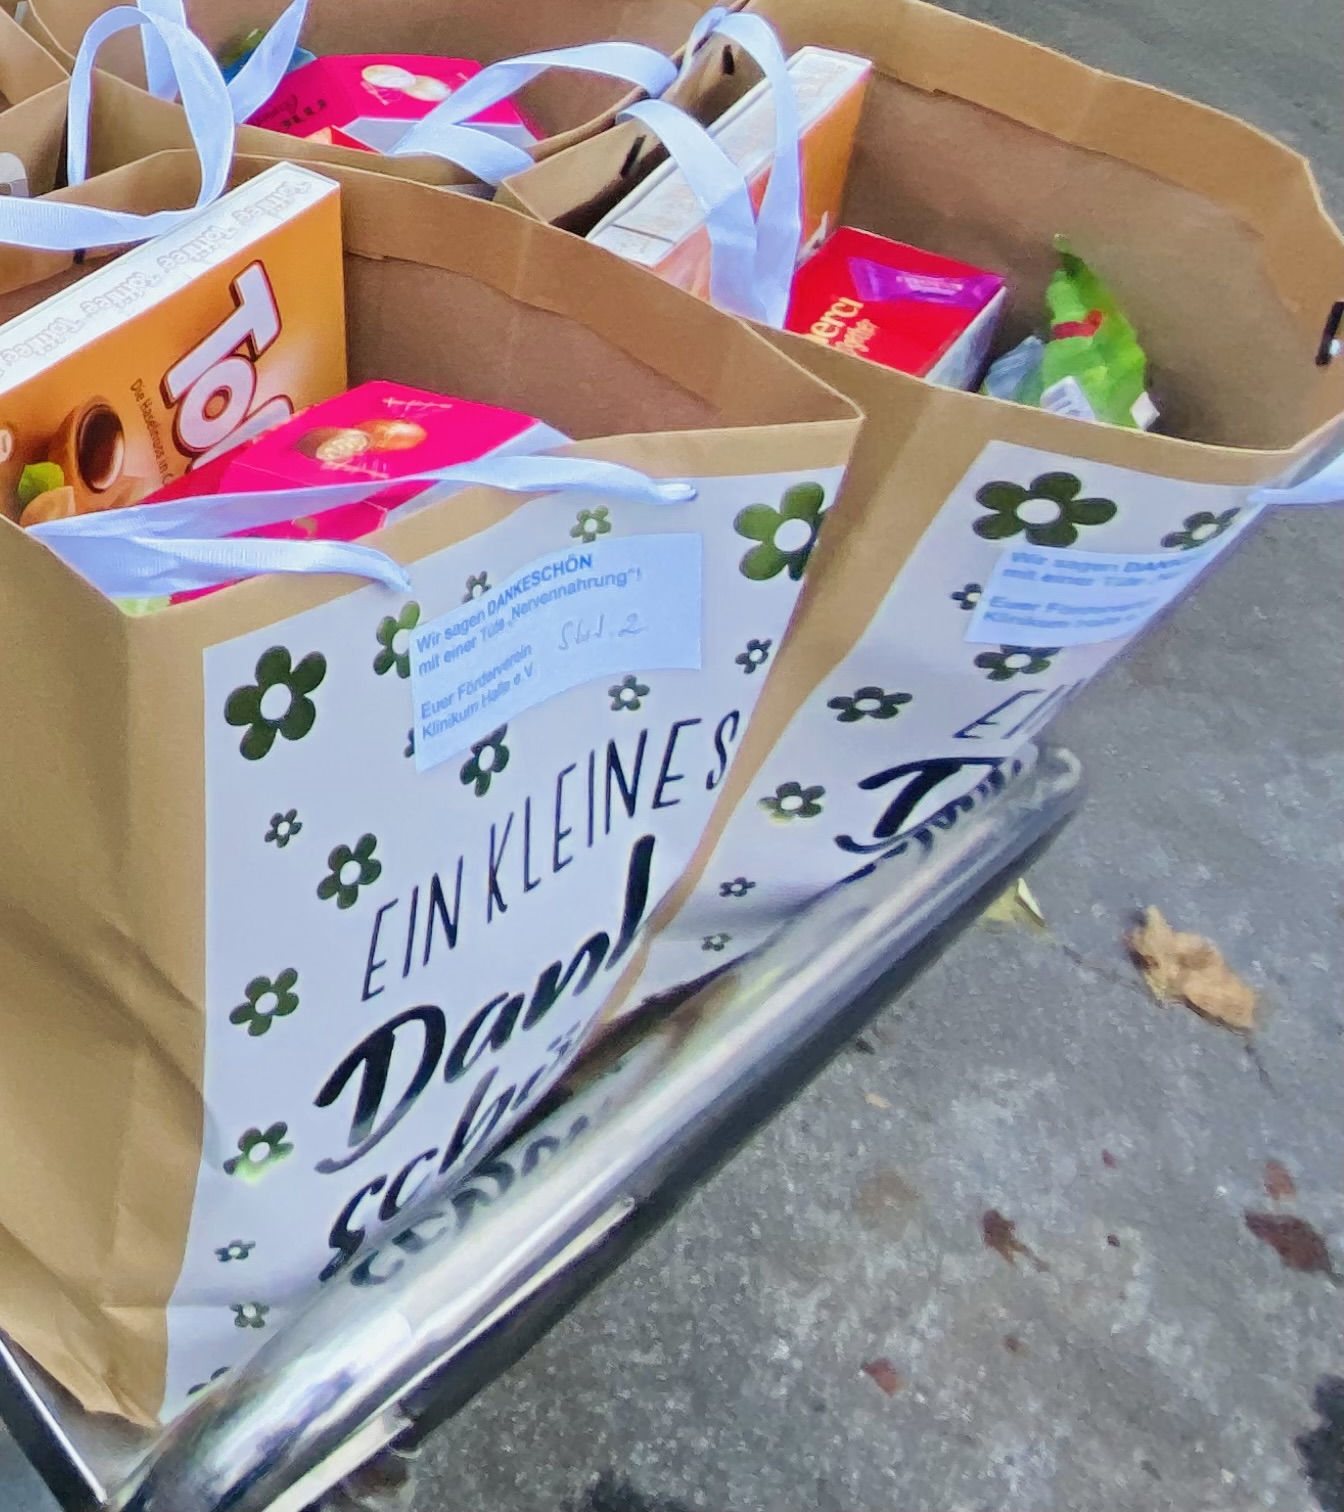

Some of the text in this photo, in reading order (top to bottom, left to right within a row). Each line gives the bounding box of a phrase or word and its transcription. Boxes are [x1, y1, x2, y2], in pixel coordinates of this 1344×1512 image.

[416, 553, 593, 654] Wir sagen DANKESCHÖN
[418, 653, 440, 677] mit
[421, 693, 454, 720] Euer
[422, 701, 479, 741] Klinikum
[361, 855, 464, 1002] EIN
[487, 710, 740, 924] KLEINES
